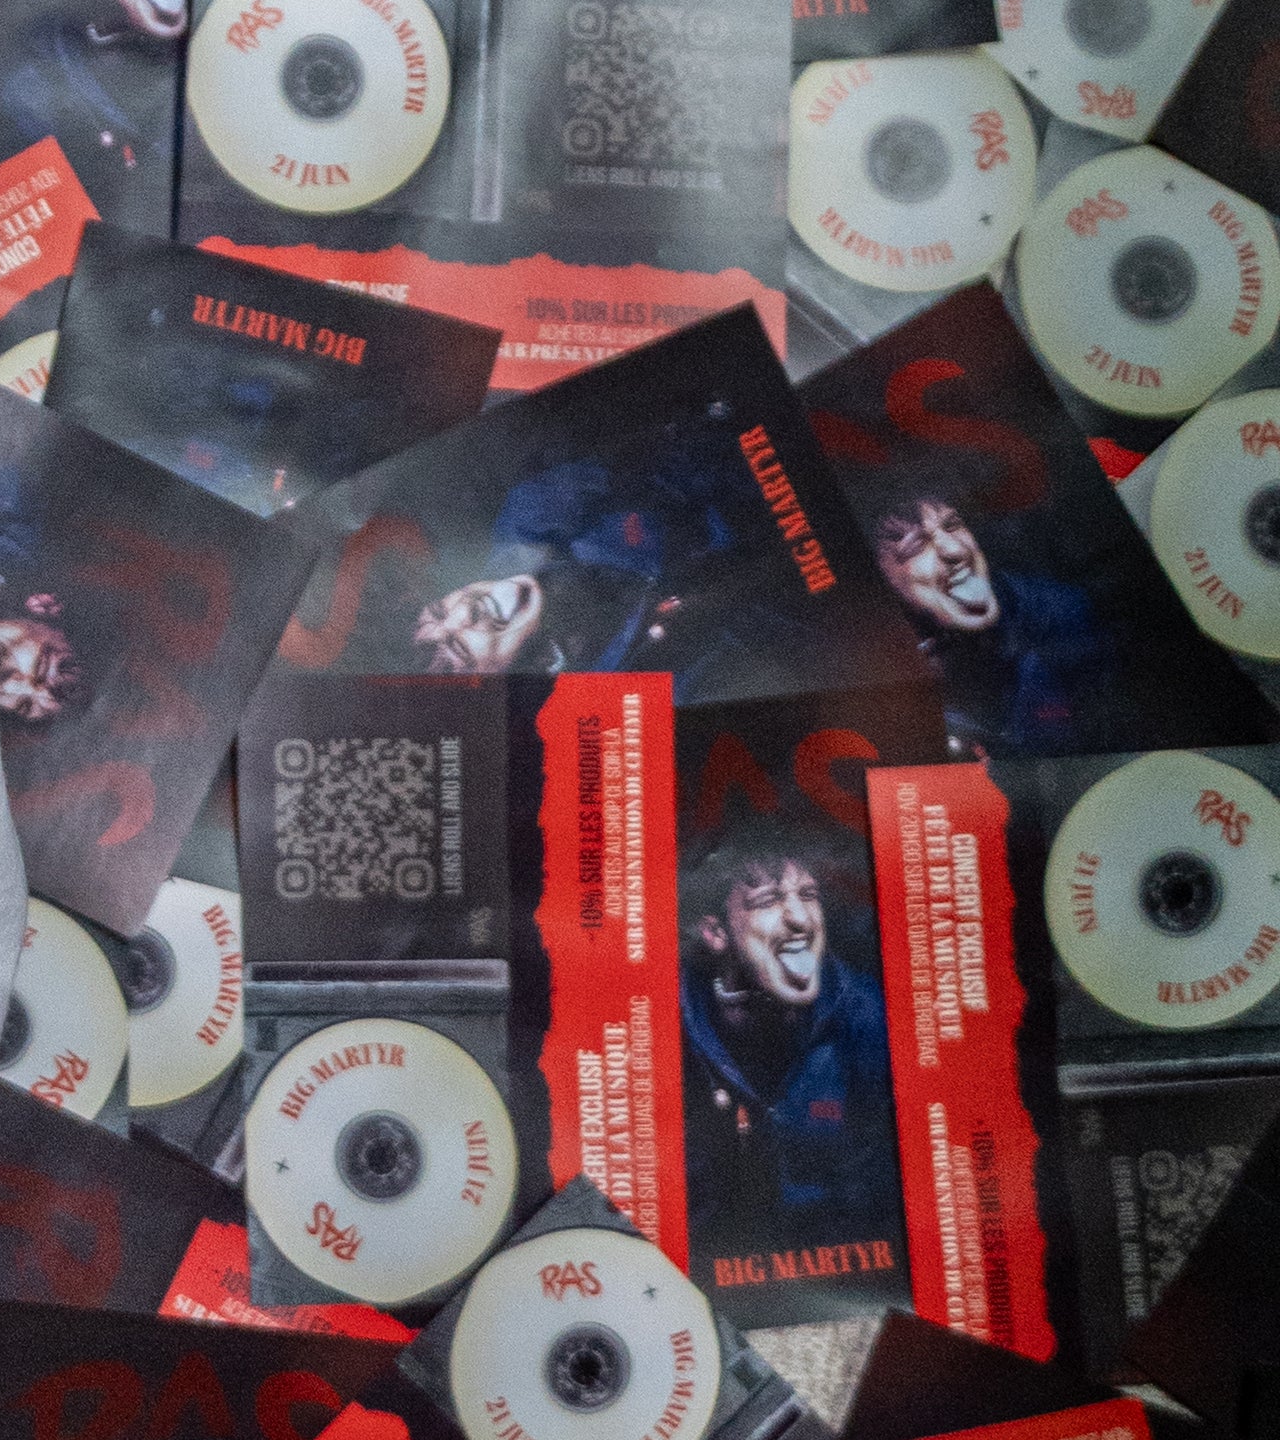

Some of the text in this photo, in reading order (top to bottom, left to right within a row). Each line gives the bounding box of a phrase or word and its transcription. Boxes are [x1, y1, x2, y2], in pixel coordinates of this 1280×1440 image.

[188, 292, 367, 366] BIG MARTYR
[735, 422, 837, 594] BIG MARTYR
[619, 691, 642, 744] FLYER
[572, 715, 607, 806] PRODUITS
[623, 749, 641, 769] CE
[624, 774, 642, 794] DE
[577, 809, 604, 843] LES
[576, 849, 605, 884] SUR
[626, 923, 643, 961] SUR
[279, 1043, 407, 1122] BIG MARTYR
[461, 1120, 493, 1207] 21 JUIN
[304, 1201, 363, 1265] RAS
[537, 1260, 605, 1302] RAS
[714, 1240, 894, 1287] BIG MARTYR
[669, 1329, 696, 1374] BIG
[485, 1398, 510, 1425] 21
